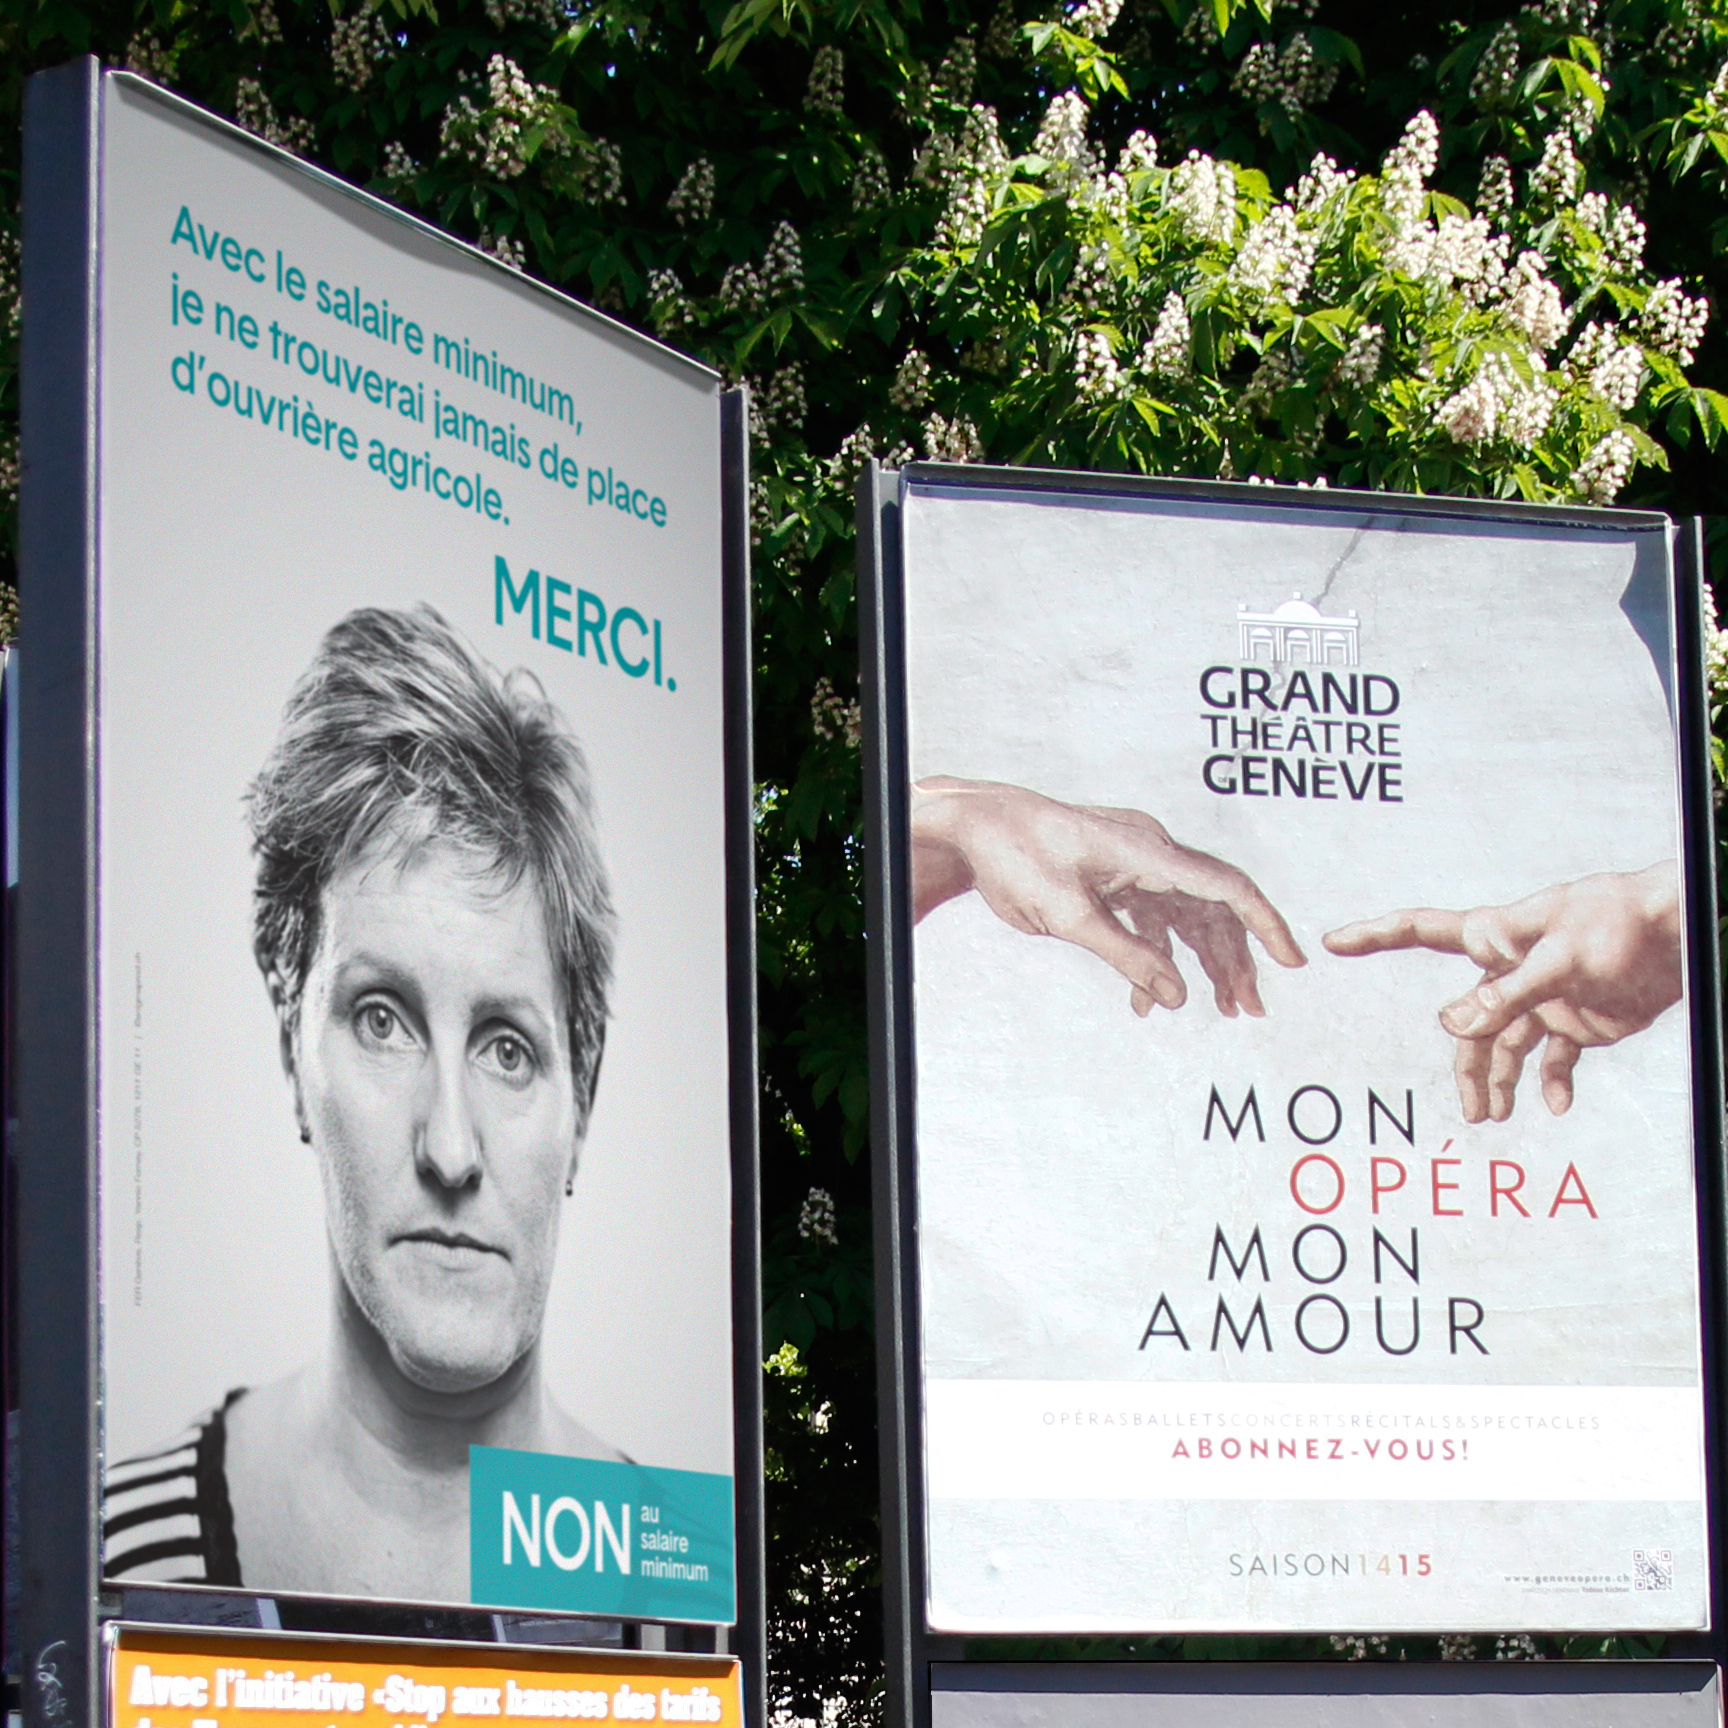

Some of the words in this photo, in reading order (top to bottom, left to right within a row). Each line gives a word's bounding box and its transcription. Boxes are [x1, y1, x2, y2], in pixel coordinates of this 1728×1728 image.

[170, 205, 266, 284] Avec
[275, 249, 307, 301] le
[316, 268, 424, 355] salaire
[433, 328, 584, 436] minimum,
[172, 273, 204, 326] je
[214, 297, 260, 351] ne
[269, 320, 425, 424] trouverai
[433, 389, 532, 470] jamais
[539, 443, 579, 491] de
[587, 464, 668, 529] place
[170, 351, 359, 461] d'ouvrière
[368, 437, 510, 526] agricole.
[494, 554, 677, 693] MERCI.
[1199, 665, 1401, 717] GRAND
[1201, 714, 1401, 758] THÉÂTRE
[1203, 754, 1405, 803] GENÈVE
[1203, 1082, 1416, 1147] MON
[1289, 1139, 1600, 1220] OPÉRA
[1207, 1223, 1421, 1287] MON
[1138, 1292, 1491, 1357] AMOUR
[1171, 1436, 1470, 1463] ABONNEZ-VOUS!
[502, 1490, 631, 1576] NON
[641, 1503, 661, 1525] au
[641, 1528, 690, 1554] salaire
[641, 1553, 710, 1584] minimum
[129, 1664, 209, 1708] Avec
[214, 1668, 365, 1714] l'initiative
[373, 1673, 447, 1721] «Stop
[451, 1684, 502, 1718] aux
[506, 1680, 608, 1721] hausses
[613, 1683, 656, 1721] des
[660, 1686, 721, 1724] tarifs
